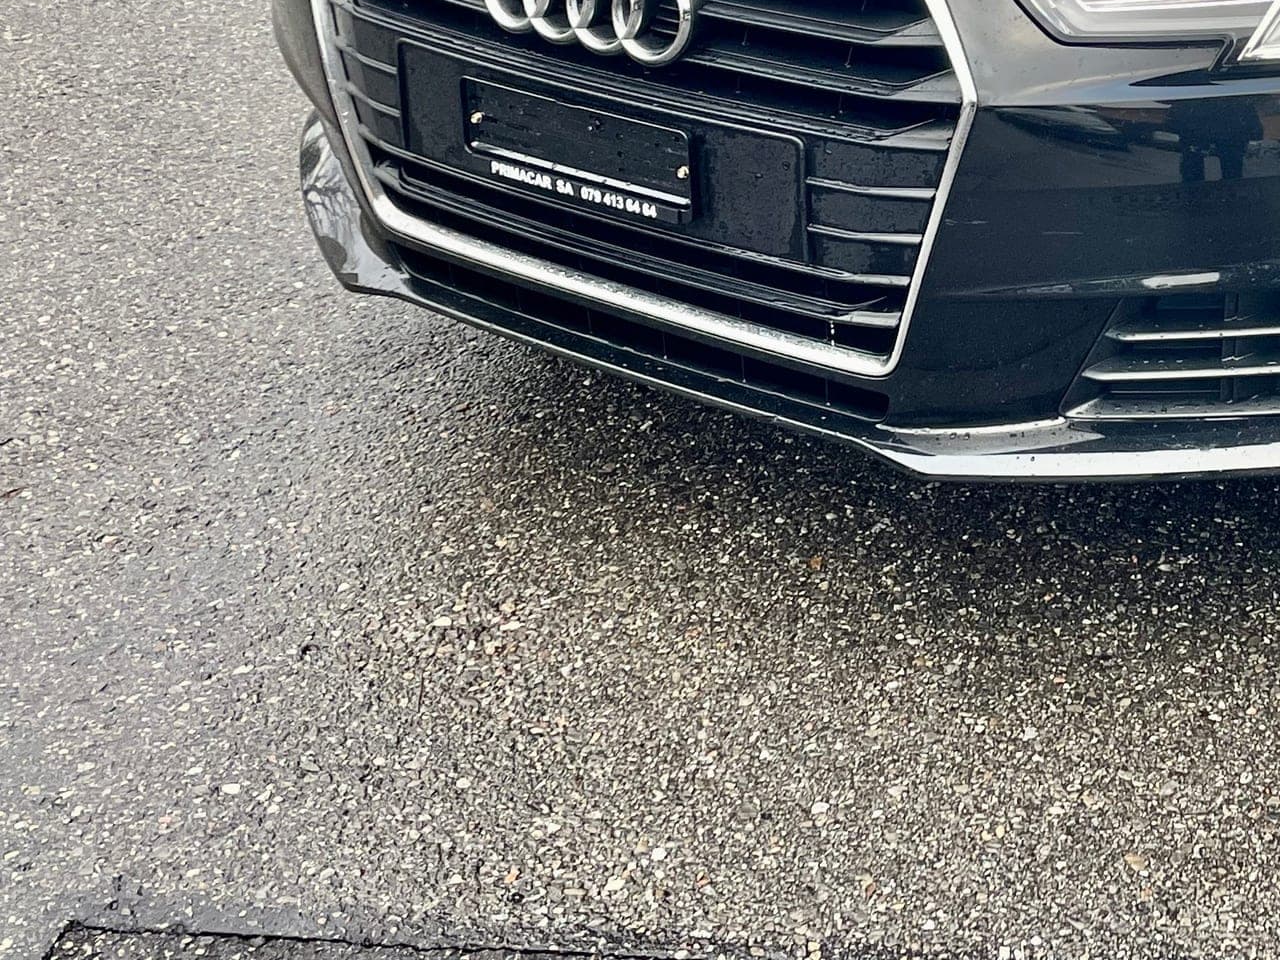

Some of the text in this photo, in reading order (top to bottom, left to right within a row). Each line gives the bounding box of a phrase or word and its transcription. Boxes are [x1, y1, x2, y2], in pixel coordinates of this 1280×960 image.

[490, 161, 658, 219] PRIMACAR SA 079 413 64 64
